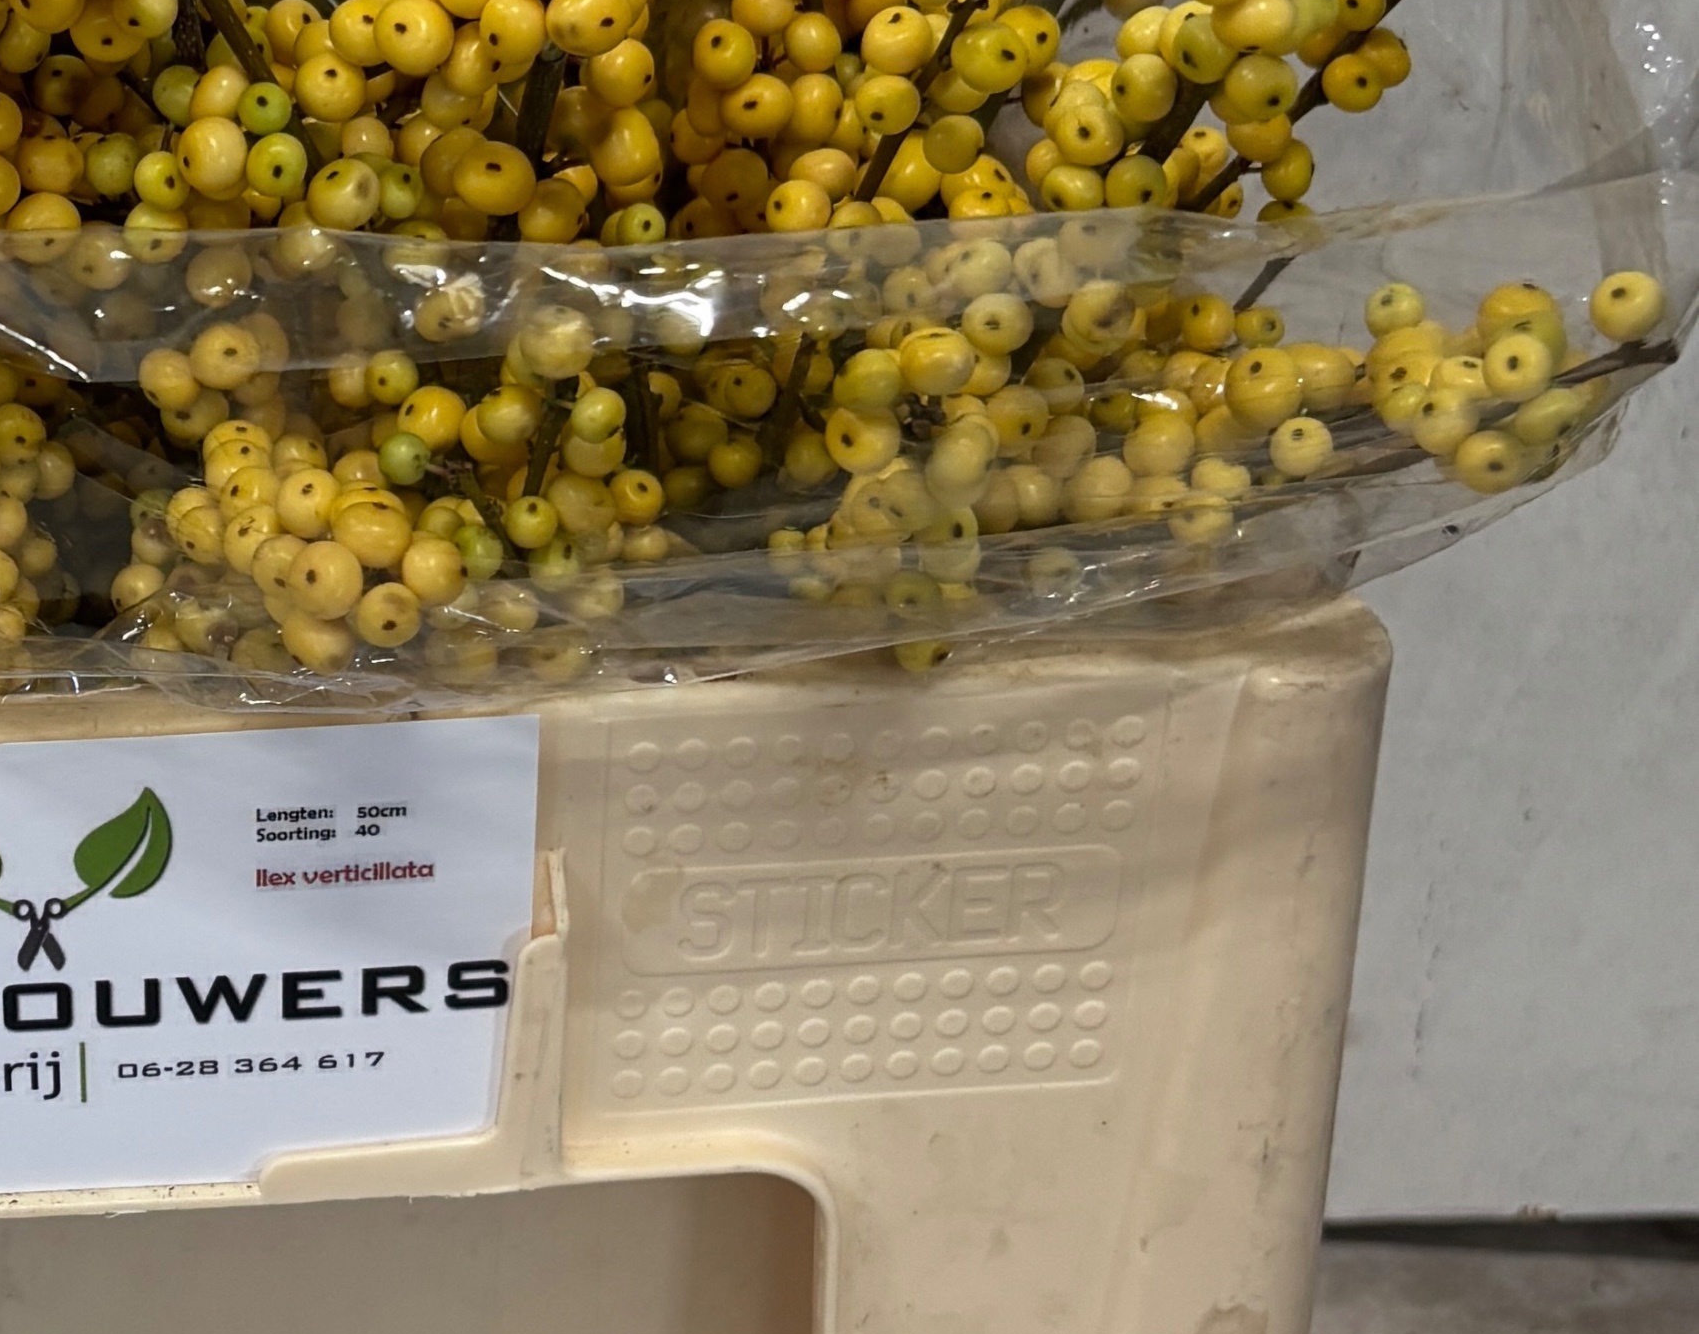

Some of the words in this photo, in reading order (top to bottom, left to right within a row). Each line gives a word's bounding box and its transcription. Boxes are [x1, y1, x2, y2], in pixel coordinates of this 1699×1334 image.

[256, 807, 334, 822] Lengten:
[357, 805, 407, 818] 50cm
[256, 827, 336, 842] Soorting:
[355, 824, 380, 837] 40
[302, 861, 434, 884] verticillata
[678, 861, 1065, 962] STICKER
[117, 1059, 219, 1080] 06-28
[234, 1055, 303, 1075] 364
[317, 1050, 386, 1070] 617
